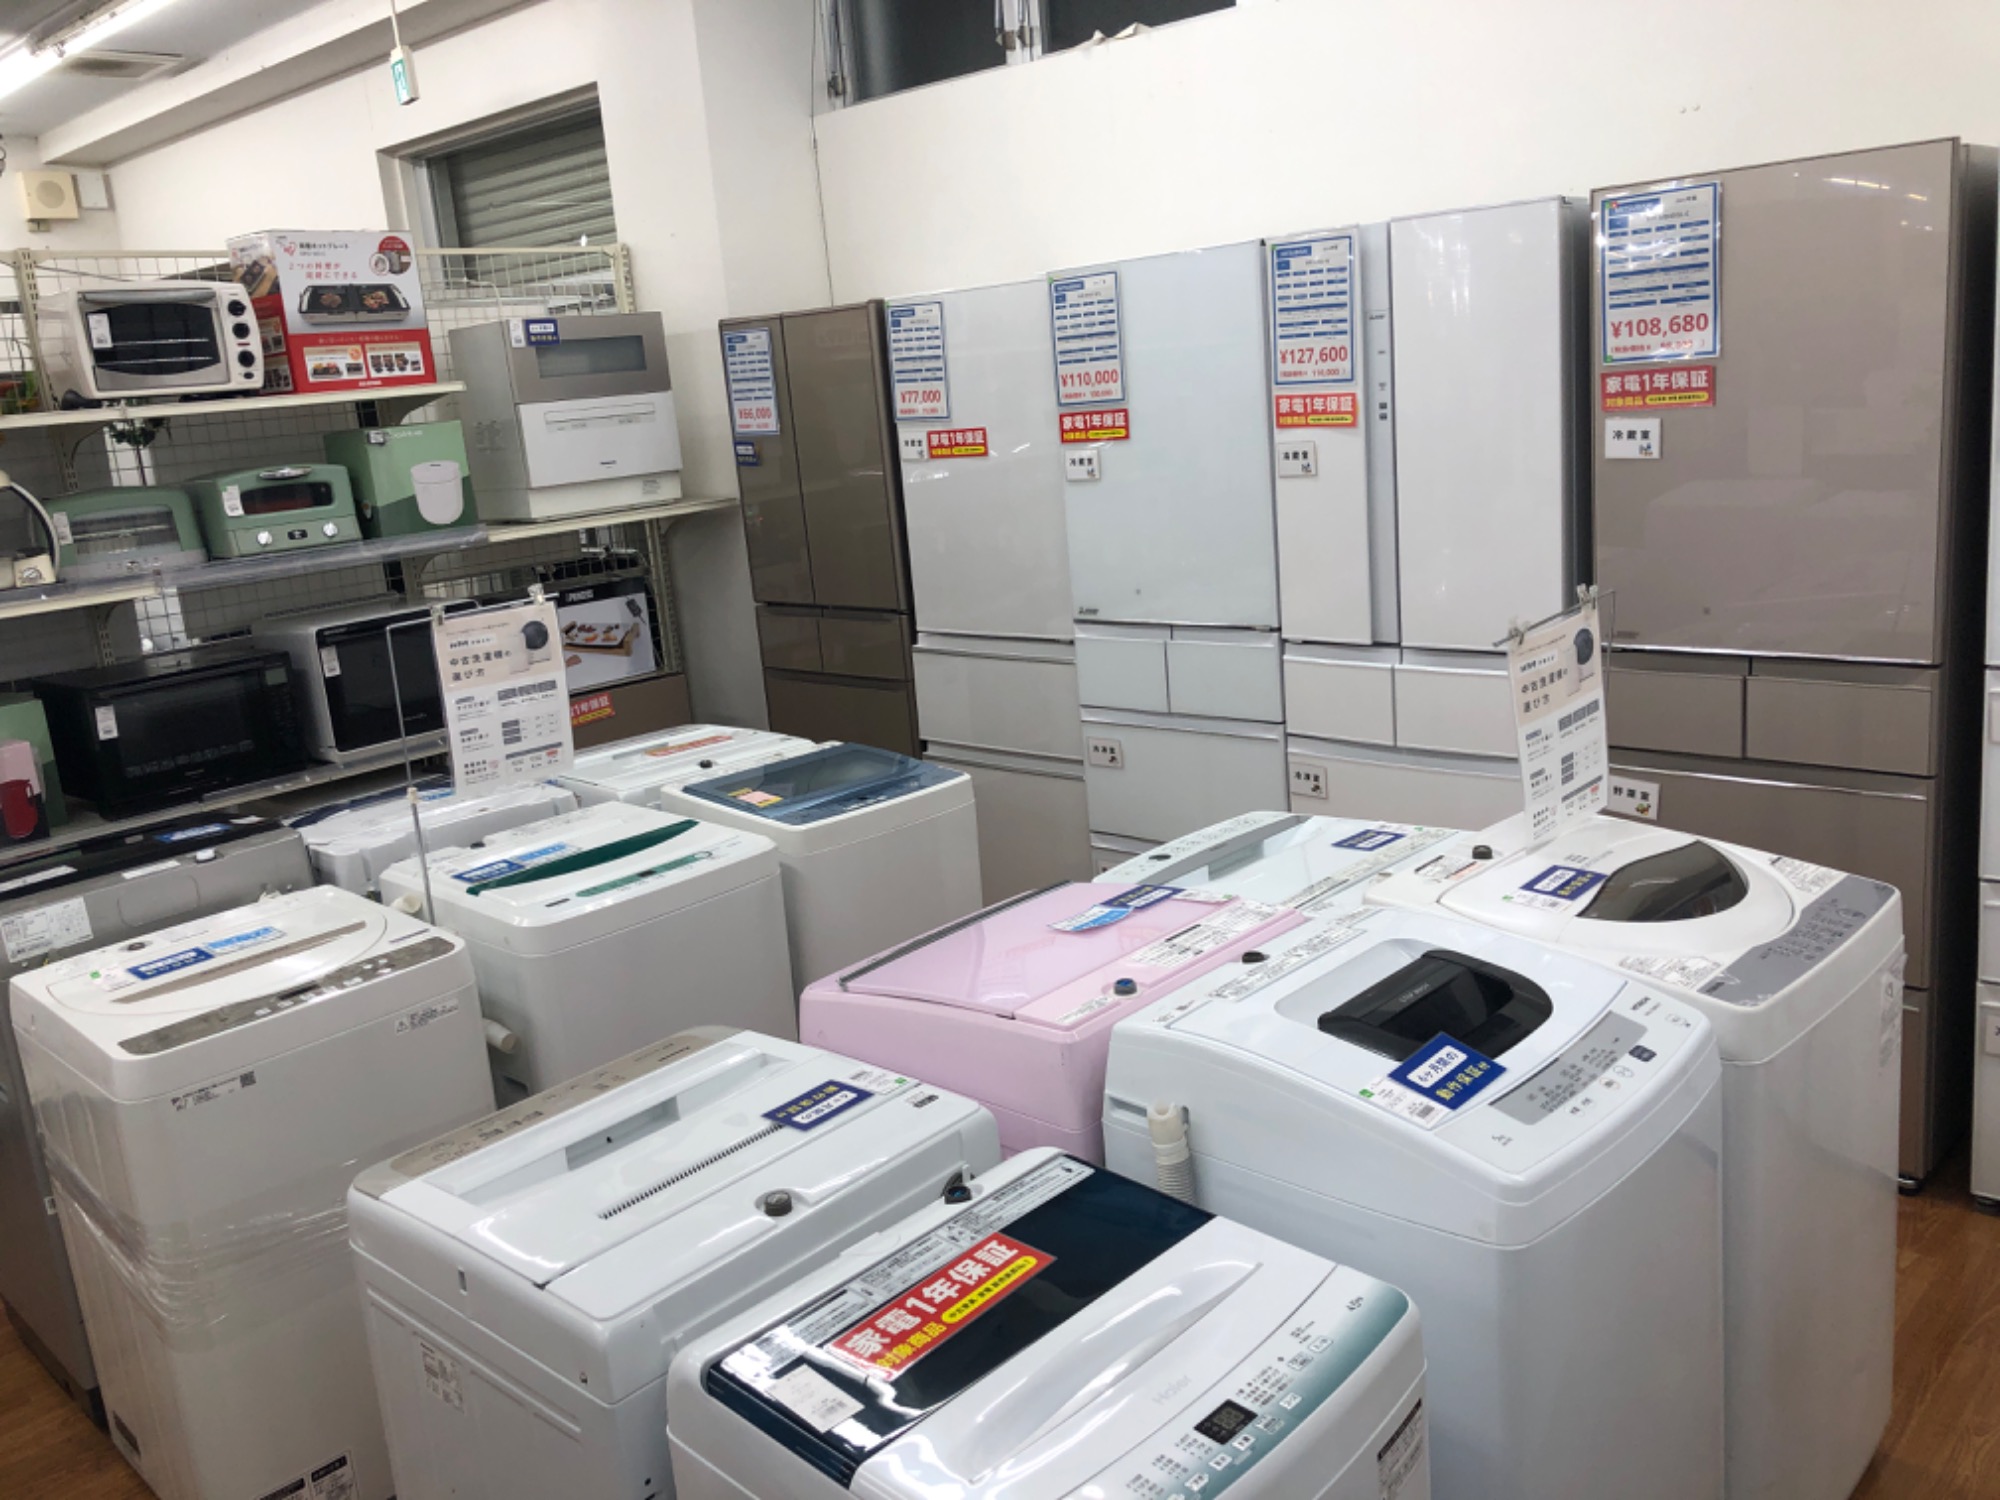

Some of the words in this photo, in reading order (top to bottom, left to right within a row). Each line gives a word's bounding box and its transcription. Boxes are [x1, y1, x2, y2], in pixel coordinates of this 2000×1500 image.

[1611, 313, 1709, 339] ¥108,680
[1280, 346, 1348, 365] ¥127,600
[1061, 369, 1118, 388] ¥110,000
[1605, 370, 1709, 394] 家電1年保証
[900, 389, 941, 404] ¥77,000
[1278, 396, 1354, 413] 家電1年保証
[1062, 412, 1126, 430] 家電1年保証
[1613, 429, 1651, 441] 冷蔵室
[449, 650, 512, 666] 中古洗濯機の
[452, 668, 486, 681] 選び方
[1521, 668, 1568, 694] 中古洗濯機の
[1523, 694, 1551, 713] 選び方
[1613, 785, 1650, 801] 野菜室
[1435, 1061, 1491, 1101] 動作保証付
[845, 1239, 1019, 1358] 家電1年保証
[875, 1321, 948, 1369] 対象商品
[1151, 1375, 1193, 1406] Haier
